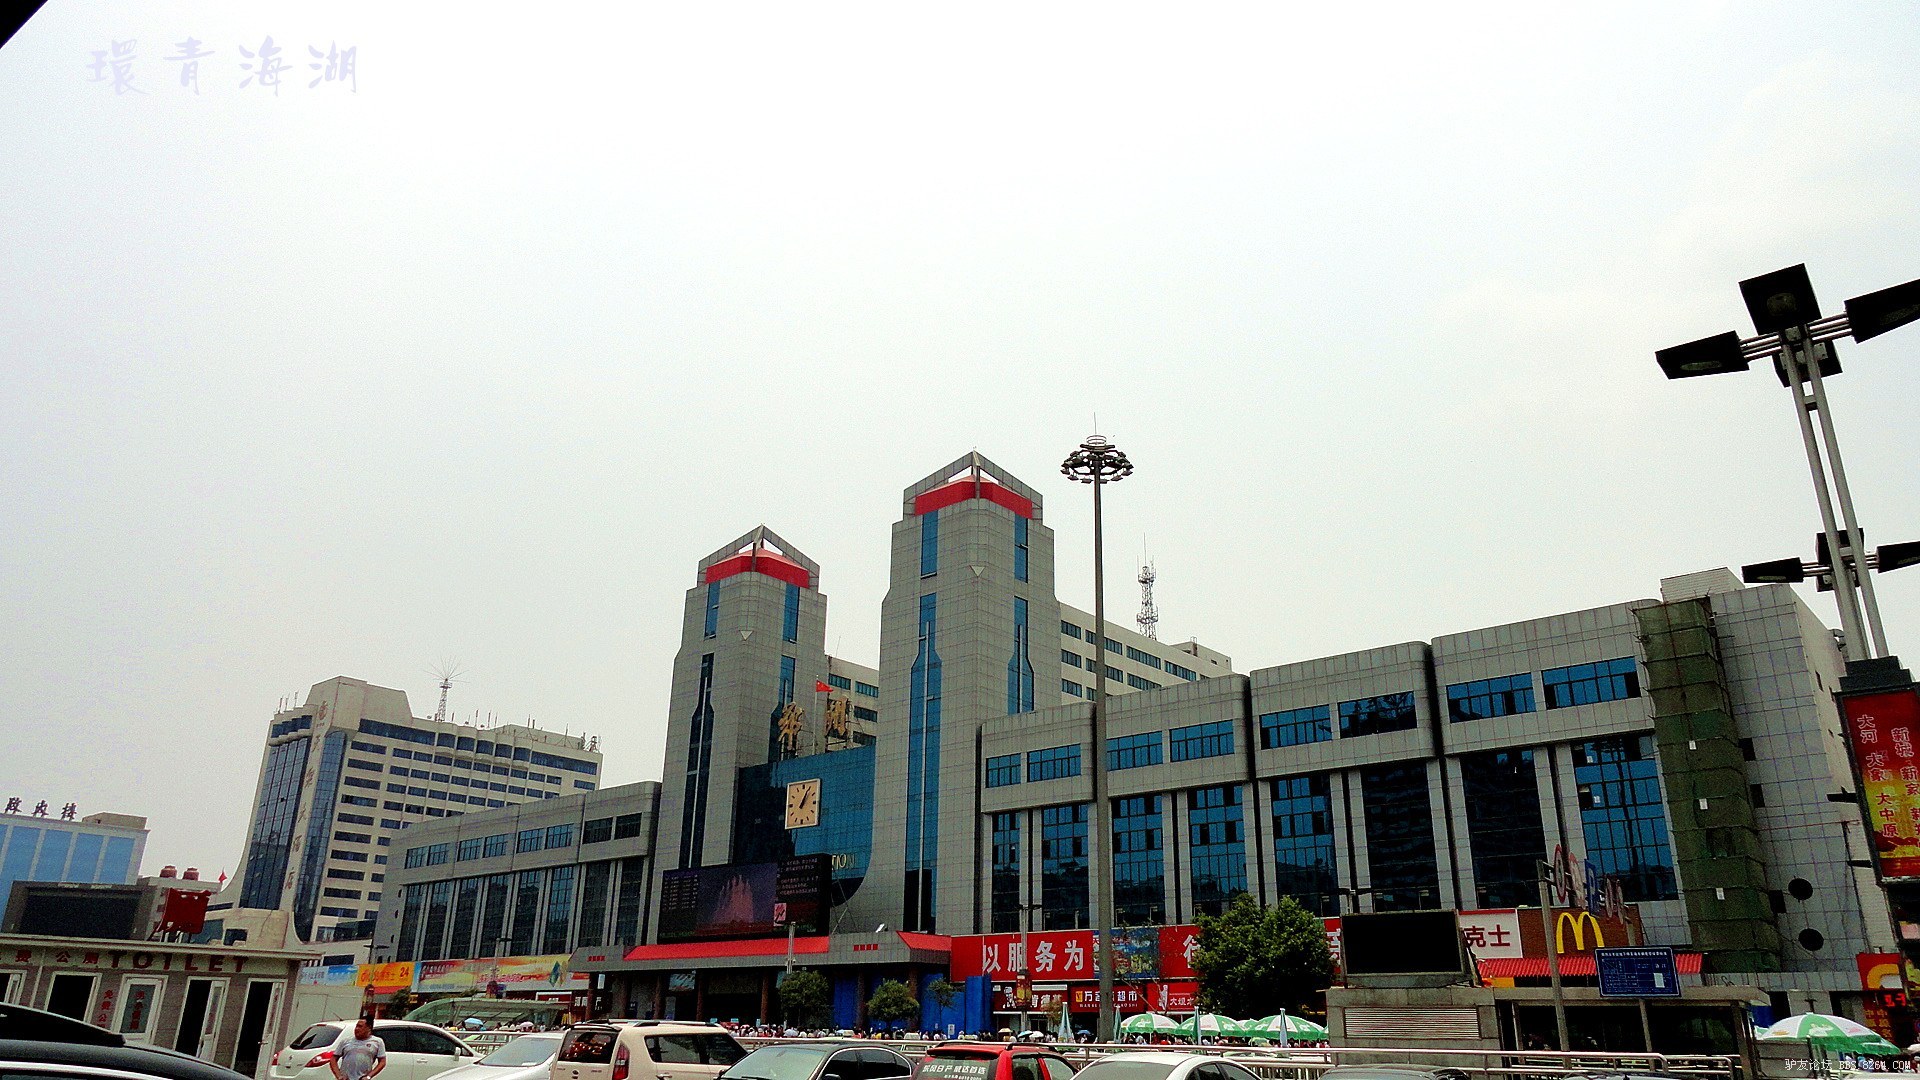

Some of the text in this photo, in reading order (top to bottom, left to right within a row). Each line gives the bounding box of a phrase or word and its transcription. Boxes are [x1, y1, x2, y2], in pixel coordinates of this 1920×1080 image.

[1857, 714, 1878, 743] 大河
[1875, 792, 1899, 838] 大中原
[108, 951, 249, 973] TOILET
[982, 939, 1084, 973] 以服务为
